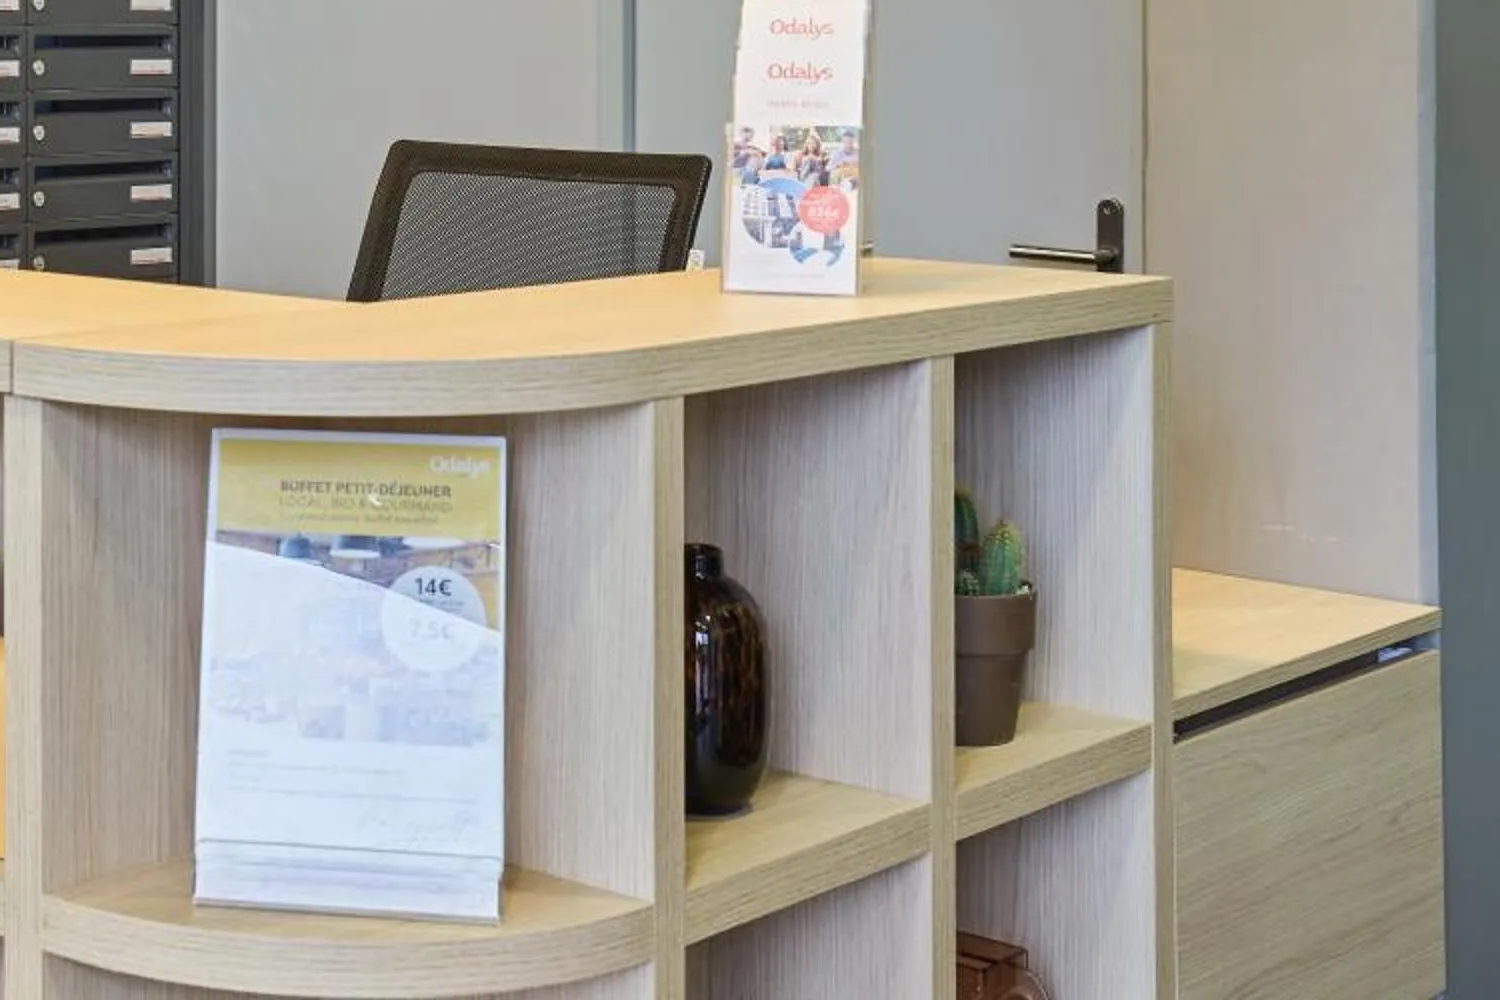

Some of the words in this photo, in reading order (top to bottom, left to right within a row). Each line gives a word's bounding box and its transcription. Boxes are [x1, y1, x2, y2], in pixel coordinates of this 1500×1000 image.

[770, 16, 834, 40] Odalys
[767, 61, 834, 85] Odalys
[280, 479, 333, 494] BUFFET
[336, 480, 452, 498] PETIT-DÉJEUNER
[414, 577, 453, 597] 14€
